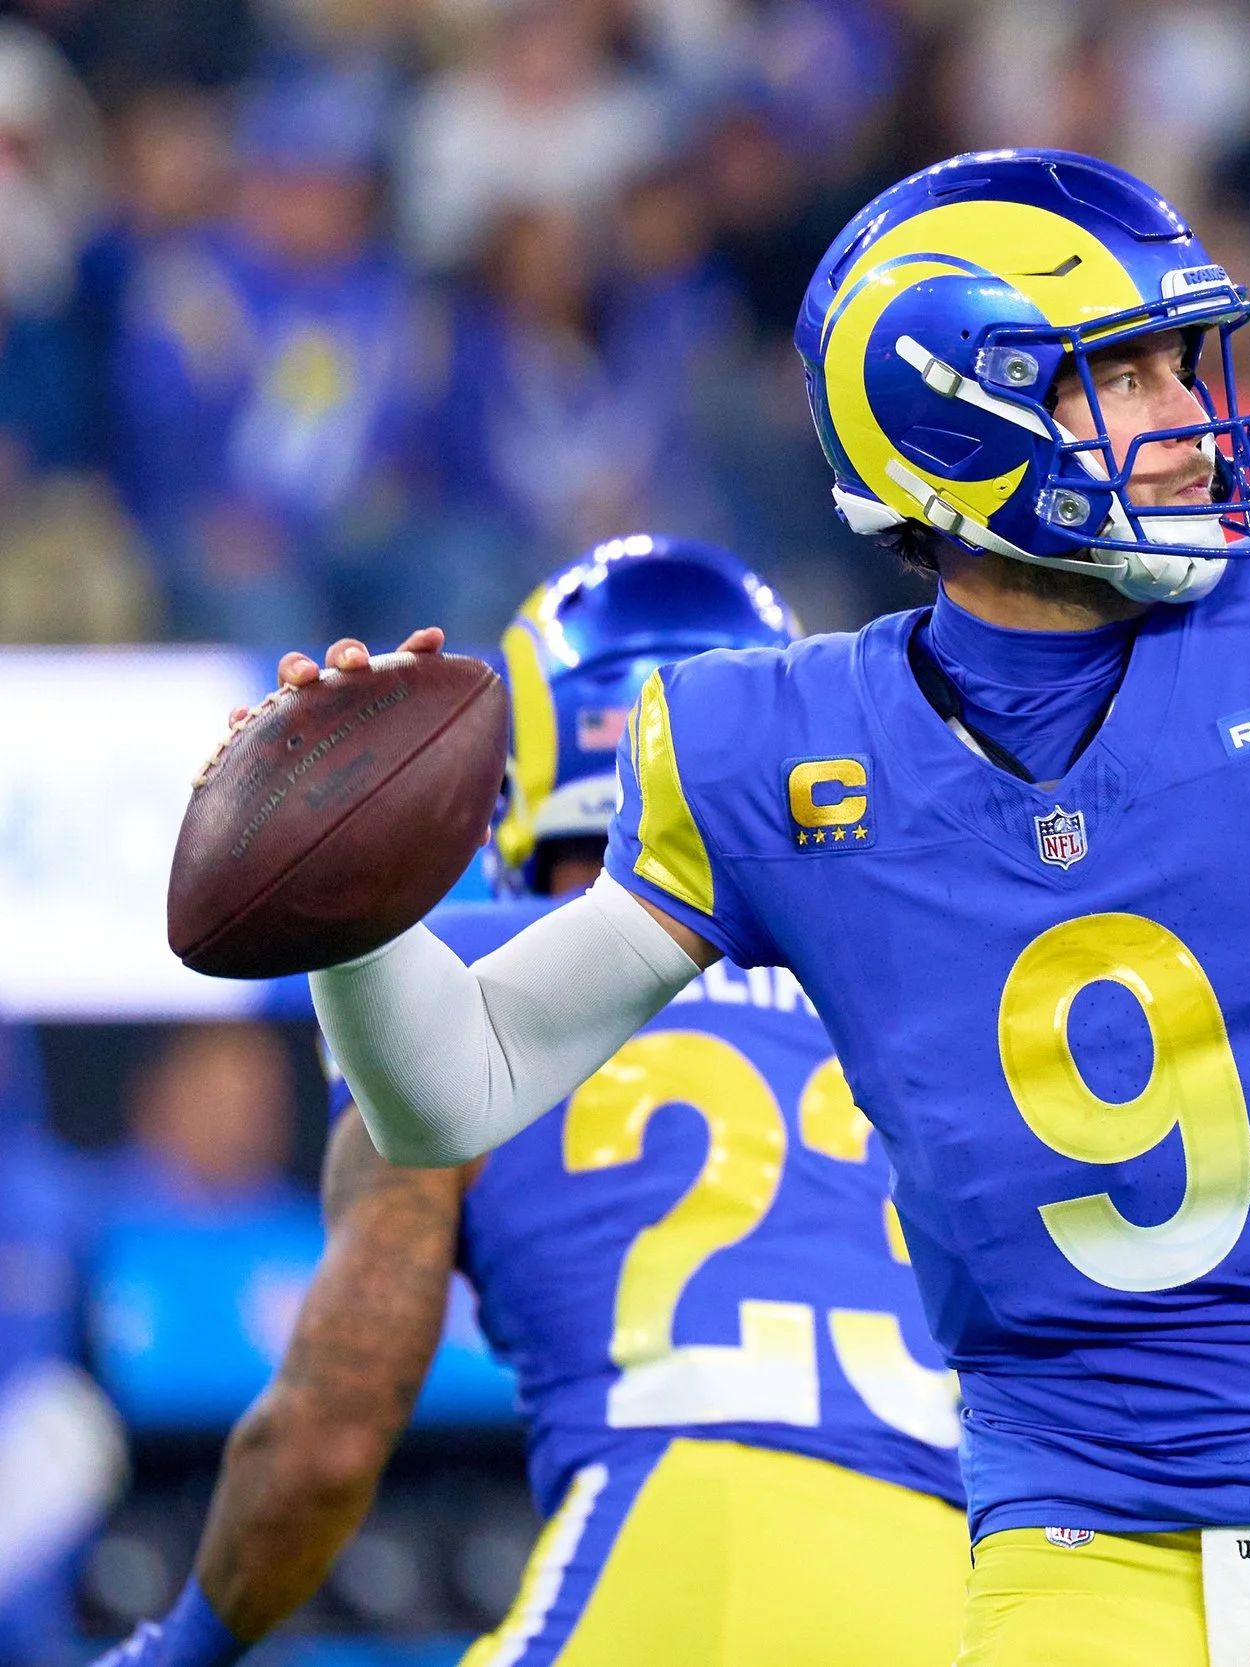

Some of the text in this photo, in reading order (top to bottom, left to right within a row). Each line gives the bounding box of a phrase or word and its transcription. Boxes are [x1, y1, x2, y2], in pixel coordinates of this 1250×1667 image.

[1183, 266, 1227, 285] RAMS
[231, 787, 288, 858] NATIONAL
[287, 721, 353, 785] FOOTBALL
[788, 758, 867, 828] C
[1045, 834, 1080, 859] NFL
